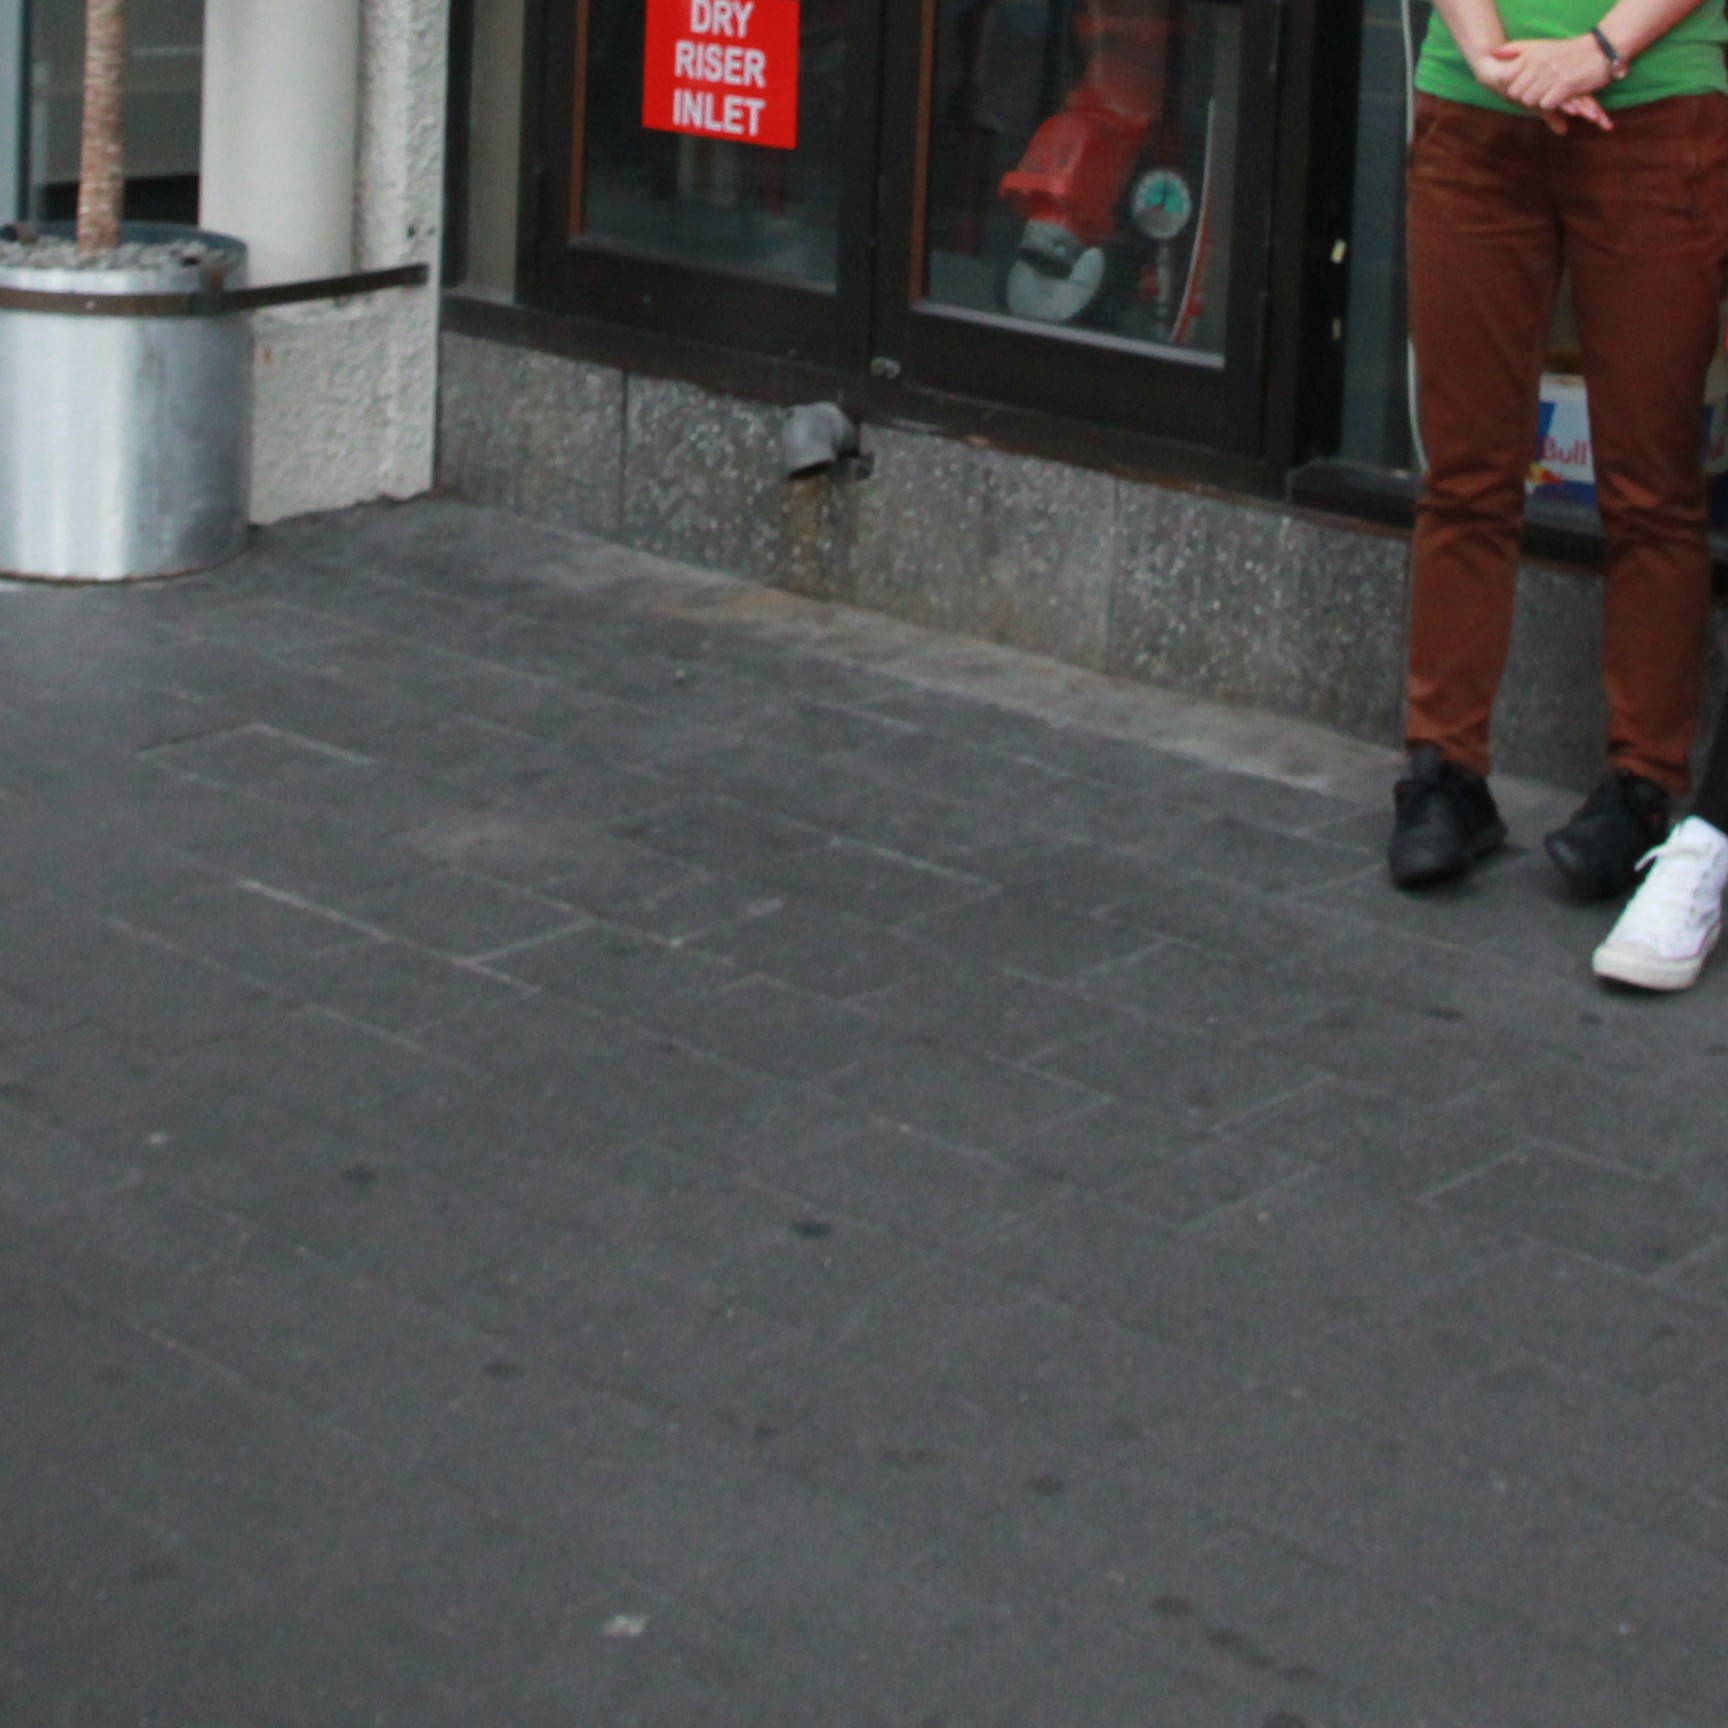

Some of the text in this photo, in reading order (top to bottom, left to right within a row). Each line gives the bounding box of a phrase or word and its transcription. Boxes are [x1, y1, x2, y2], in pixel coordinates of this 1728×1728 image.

[674, 38, 767, 90] RISER
[672, 87, 767, 138] INLET
[1543, 437, 1590, 466] Bull
